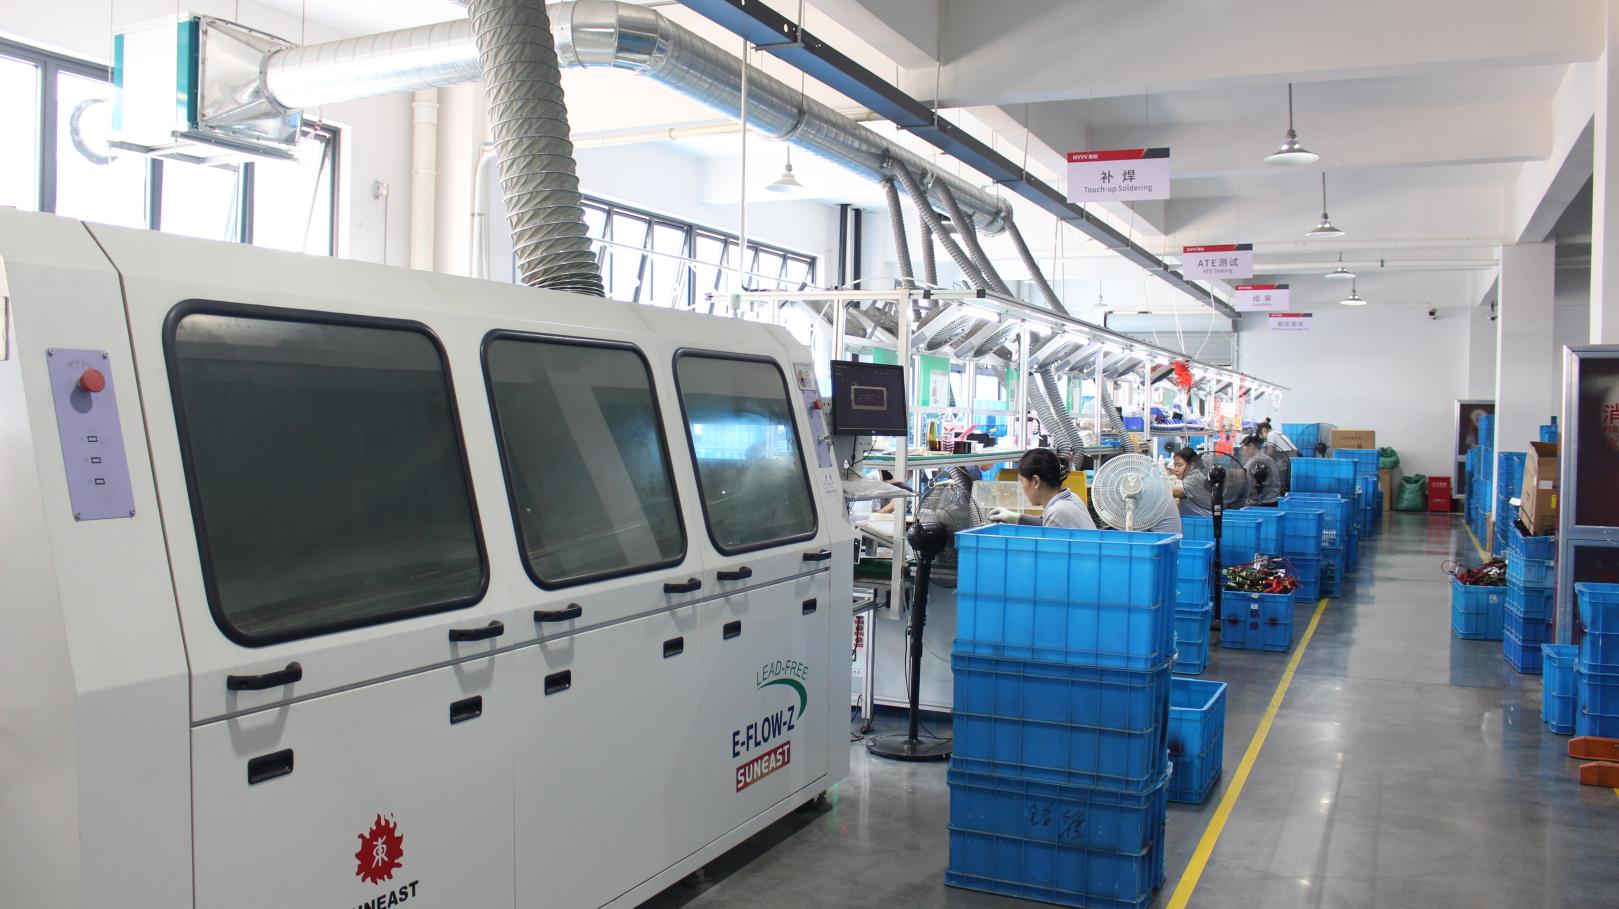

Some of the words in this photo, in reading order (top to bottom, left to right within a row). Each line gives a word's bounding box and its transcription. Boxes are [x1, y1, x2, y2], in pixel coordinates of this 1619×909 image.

[1118, 184, 1152, 192] Soldering
[756, 660, 808, 686] LEAD-FREE
[732, 704, 795, 758] E-FLOW-Z
[737, 744, 790, 788] SUNEAST
